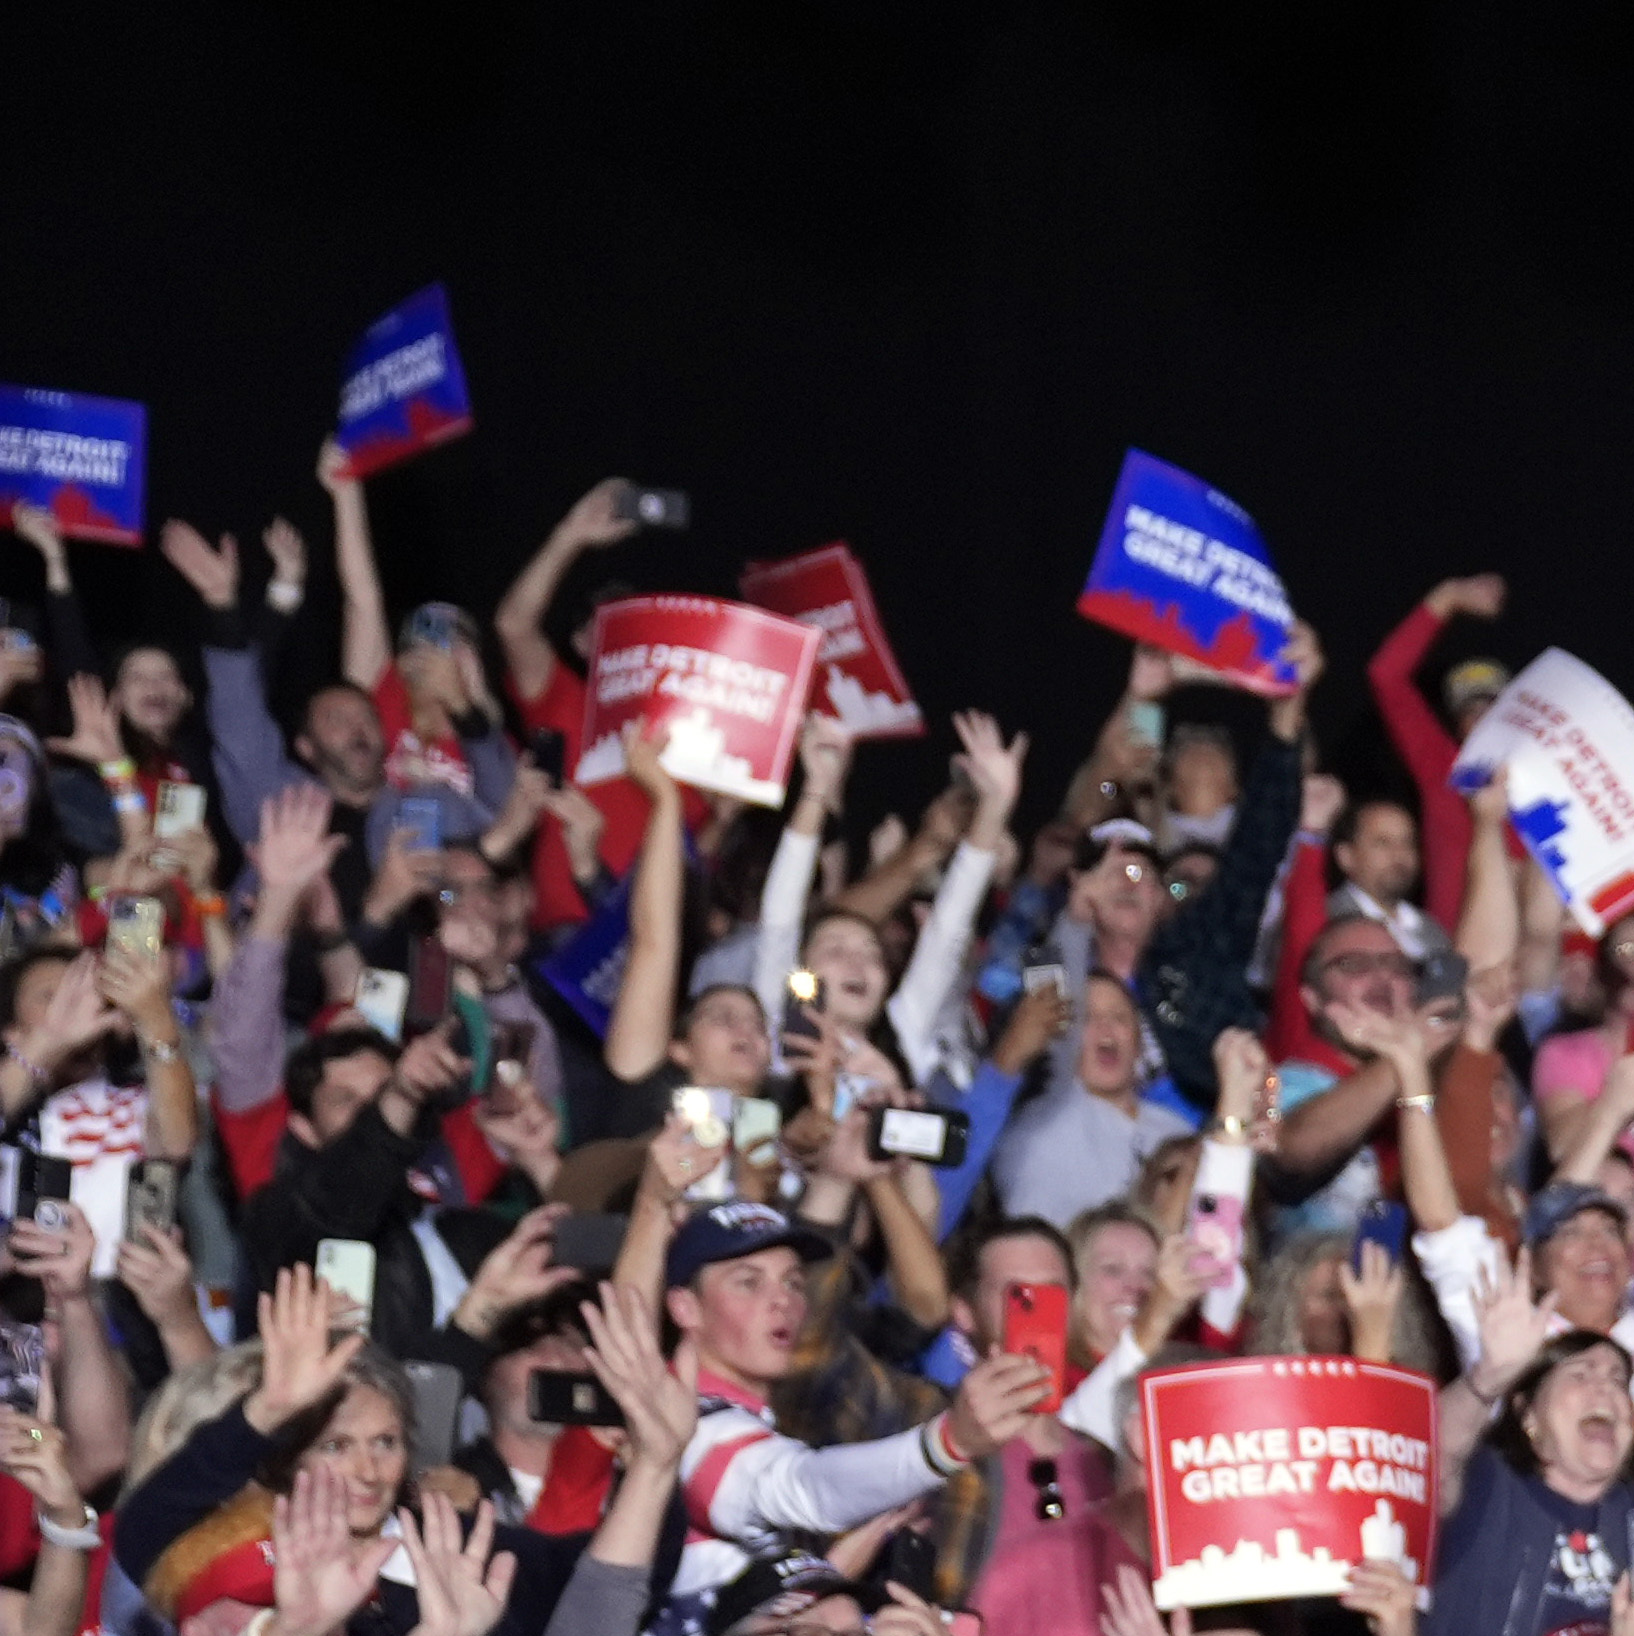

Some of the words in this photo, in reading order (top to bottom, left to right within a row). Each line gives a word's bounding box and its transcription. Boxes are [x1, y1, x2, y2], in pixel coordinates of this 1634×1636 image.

[1124, 503, 1206, 557] MAKE
[1123, 531, 1213, 592] GREAT
[1170, 1427, 1290, 1471] MAKE
[1297, 1425, 1428, 1471] DETROIT
[1181, 1461, 1318, 1503] GREAT
[1327, 1459, 1427, 1504] AGAIN!
